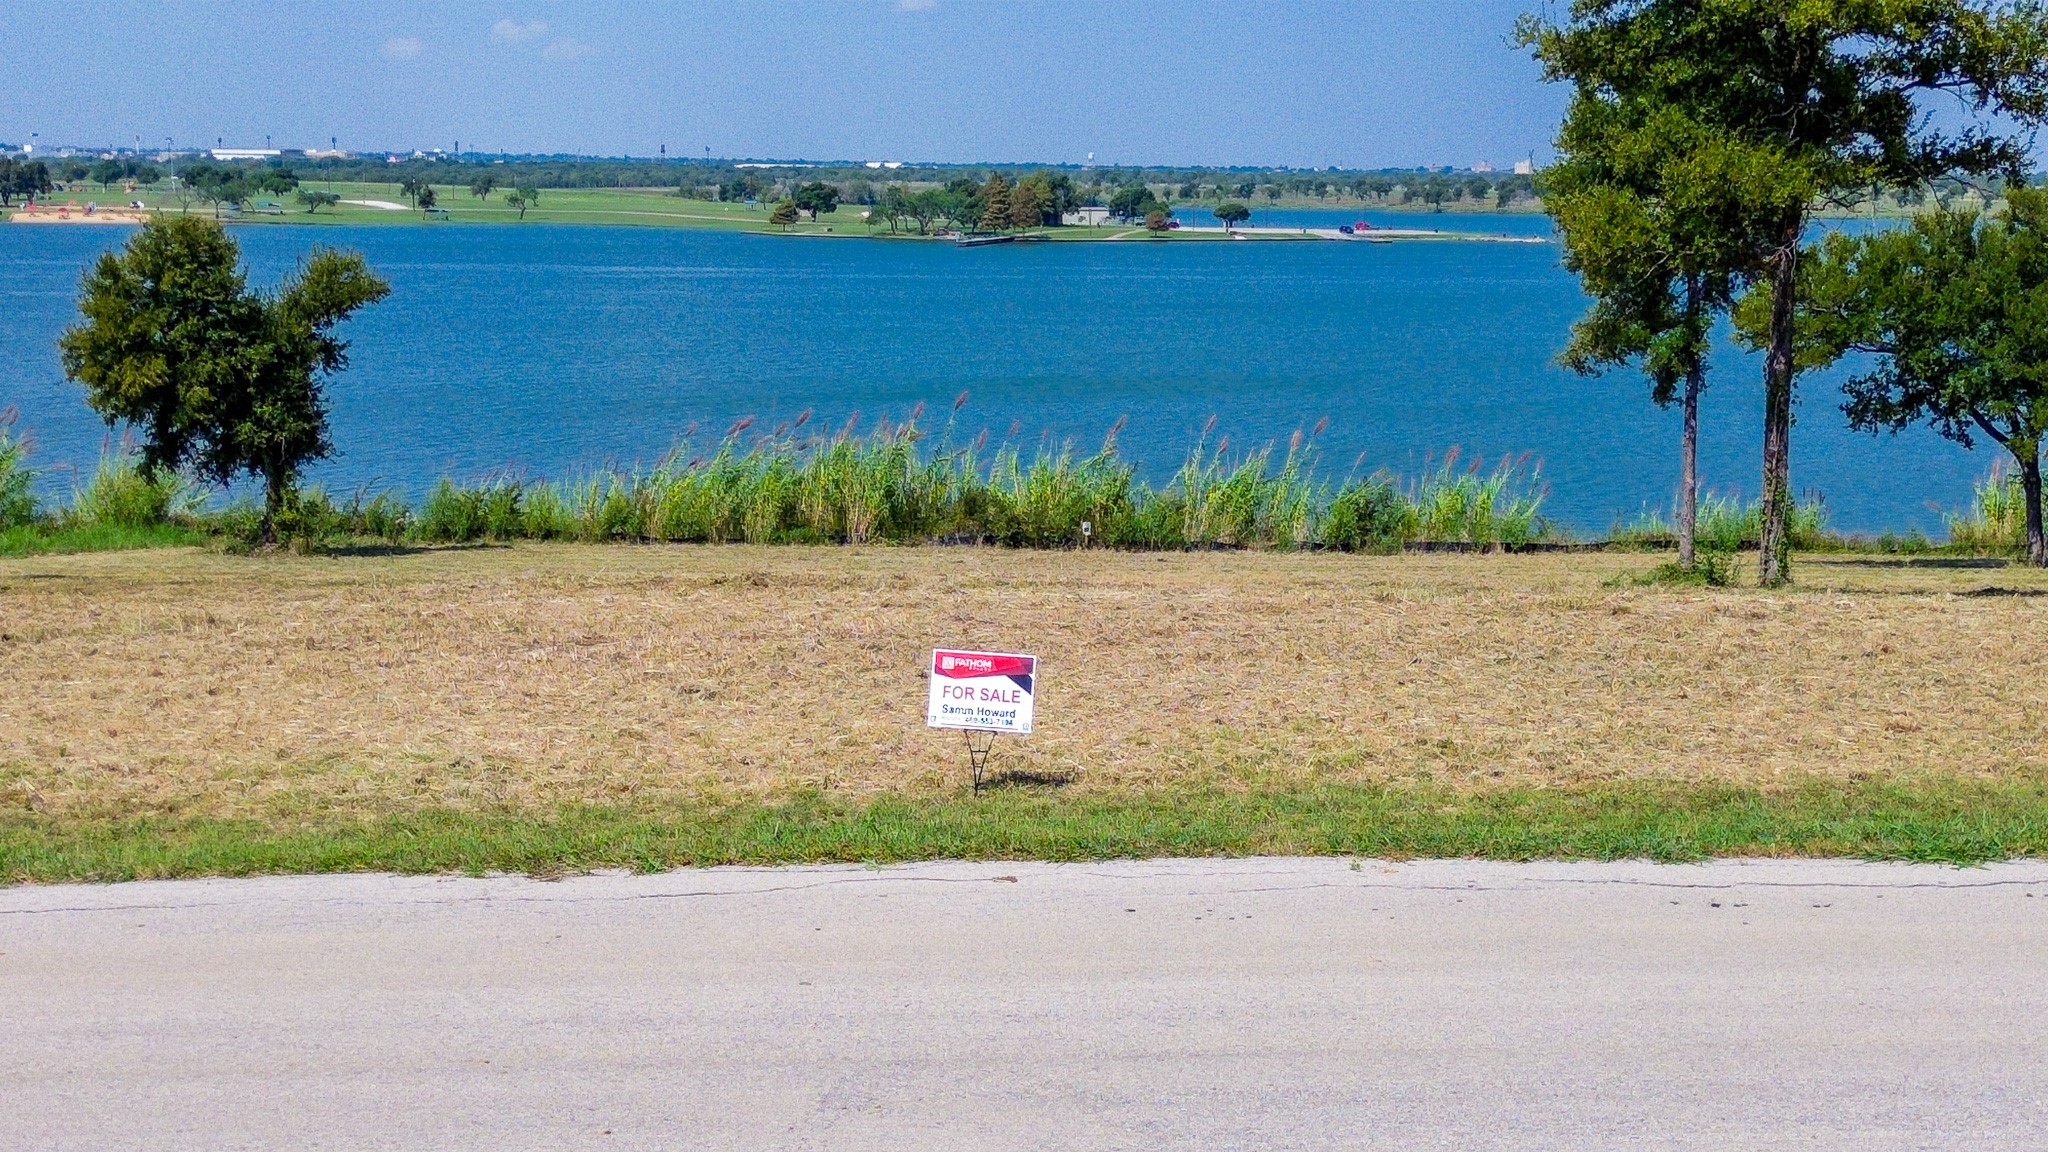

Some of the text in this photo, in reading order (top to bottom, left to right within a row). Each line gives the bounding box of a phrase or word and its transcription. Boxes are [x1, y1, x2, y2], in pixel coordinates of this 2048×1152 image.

[954, 658, 992, 670] FATHOM
[942, 685, 1021, 704] FOR SALE
[977, 707, 1016, 718] Howard
